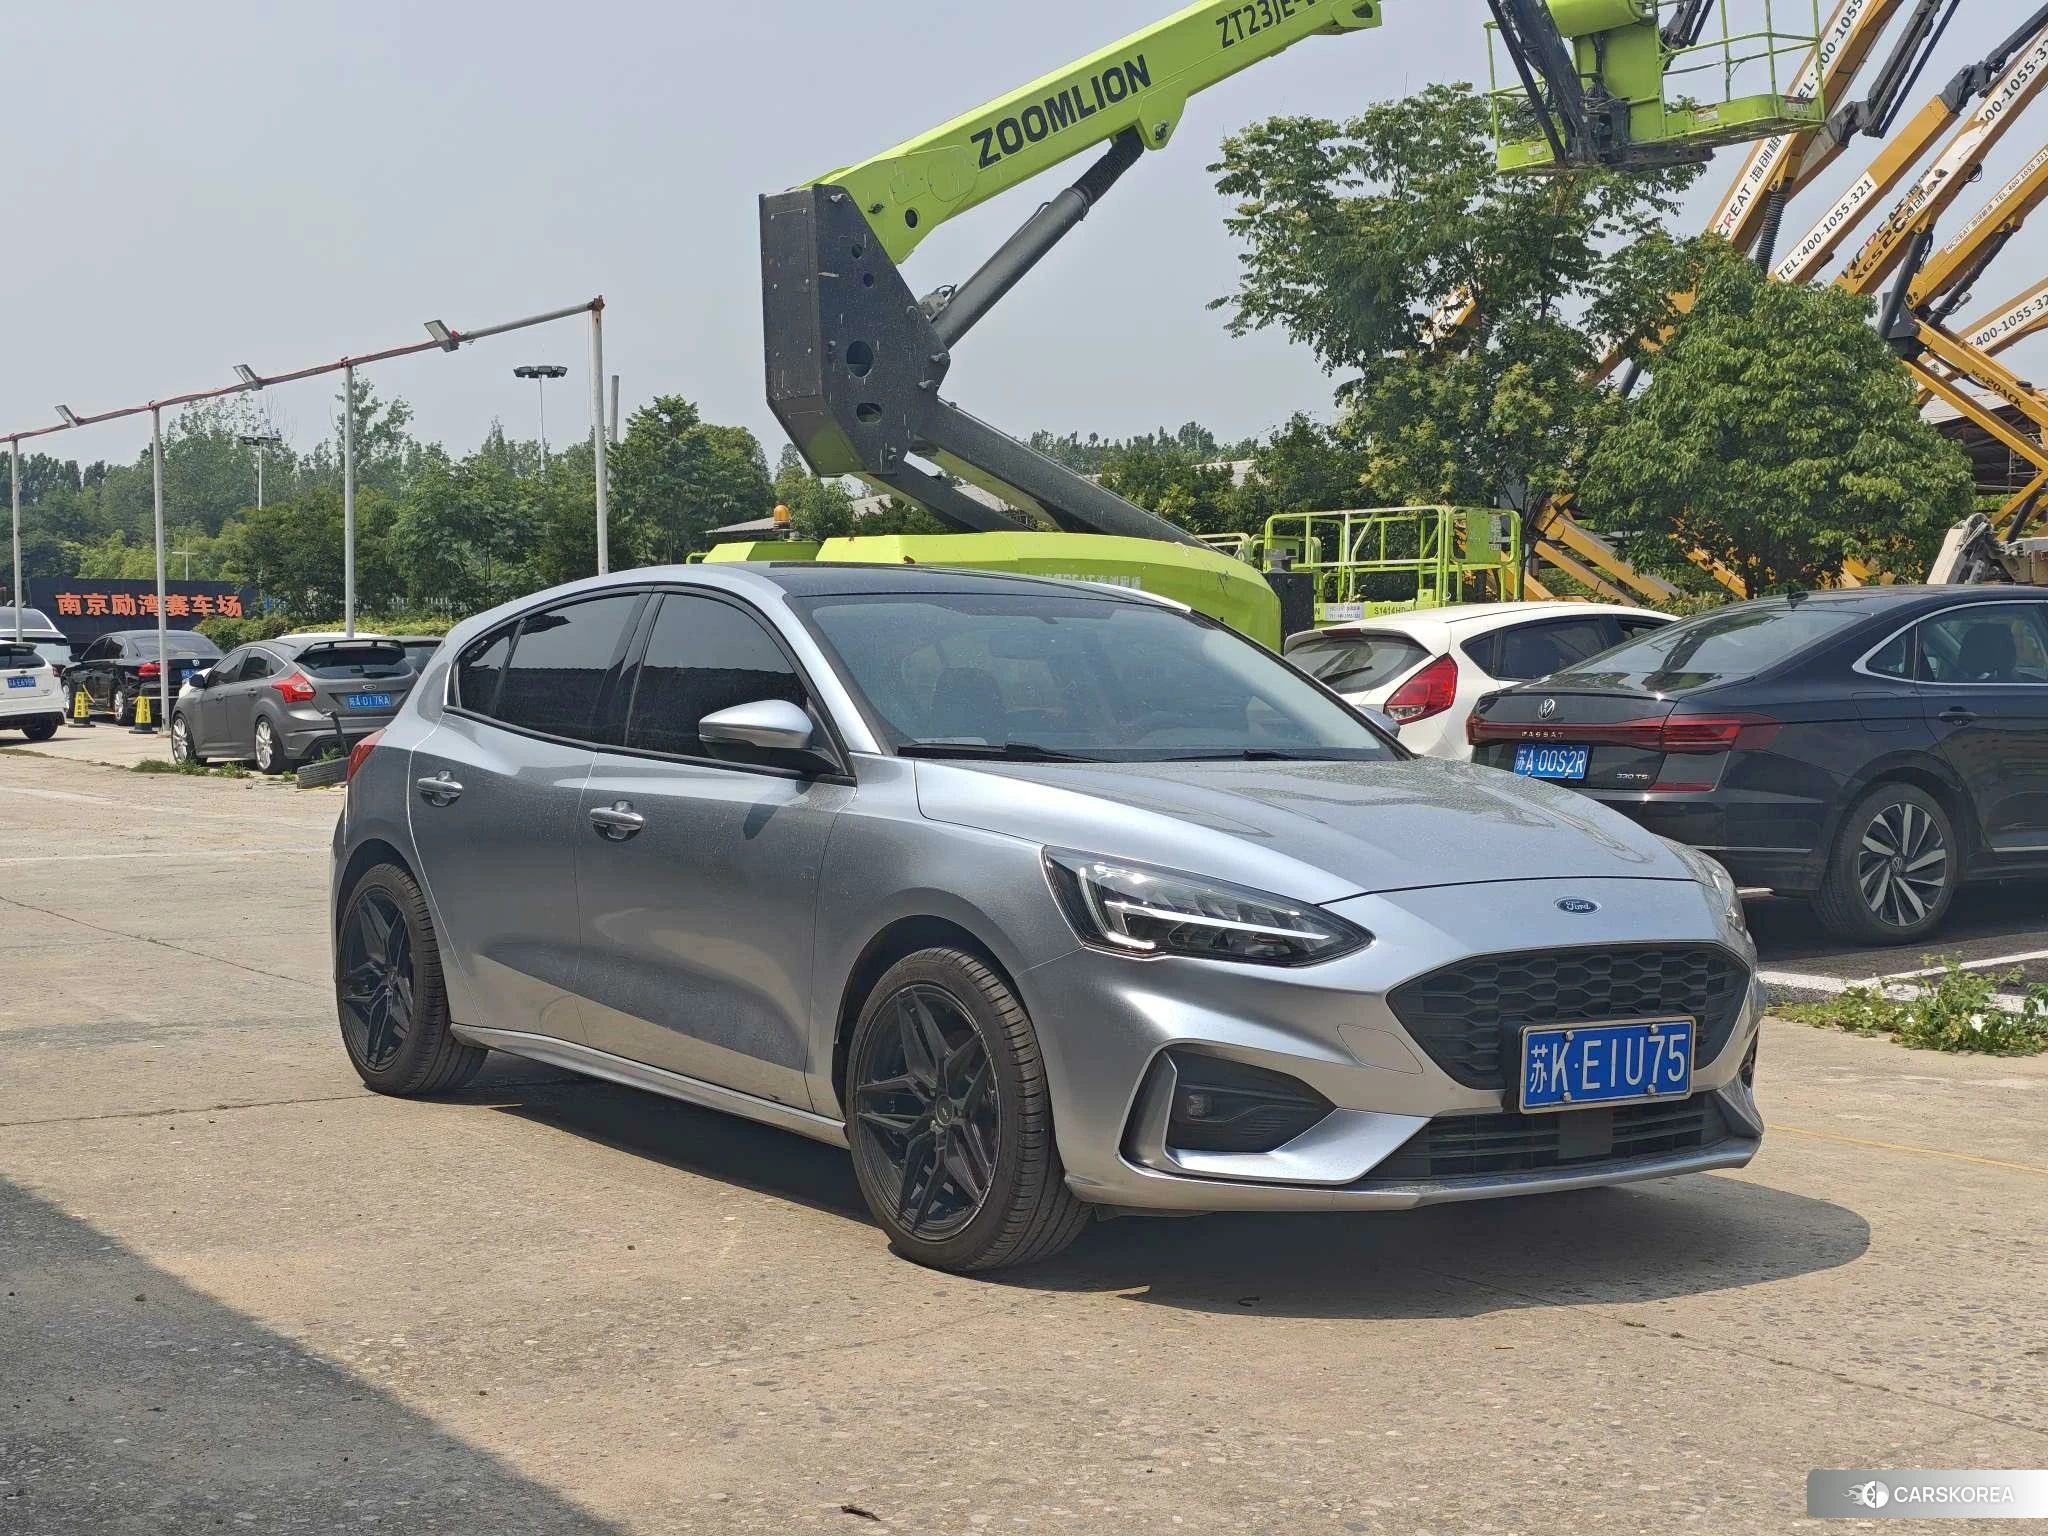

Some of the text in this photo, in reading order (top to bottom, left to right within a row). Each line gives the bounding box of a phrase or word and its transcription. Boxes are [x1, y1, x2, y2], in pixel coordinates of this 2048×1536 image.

[1216, 0, 1316, 48] ZT23JE-
[970, 54, 1152, 169] ZOOMLION
[1777, 179, 1873, 280] TEL:400-1055-321
